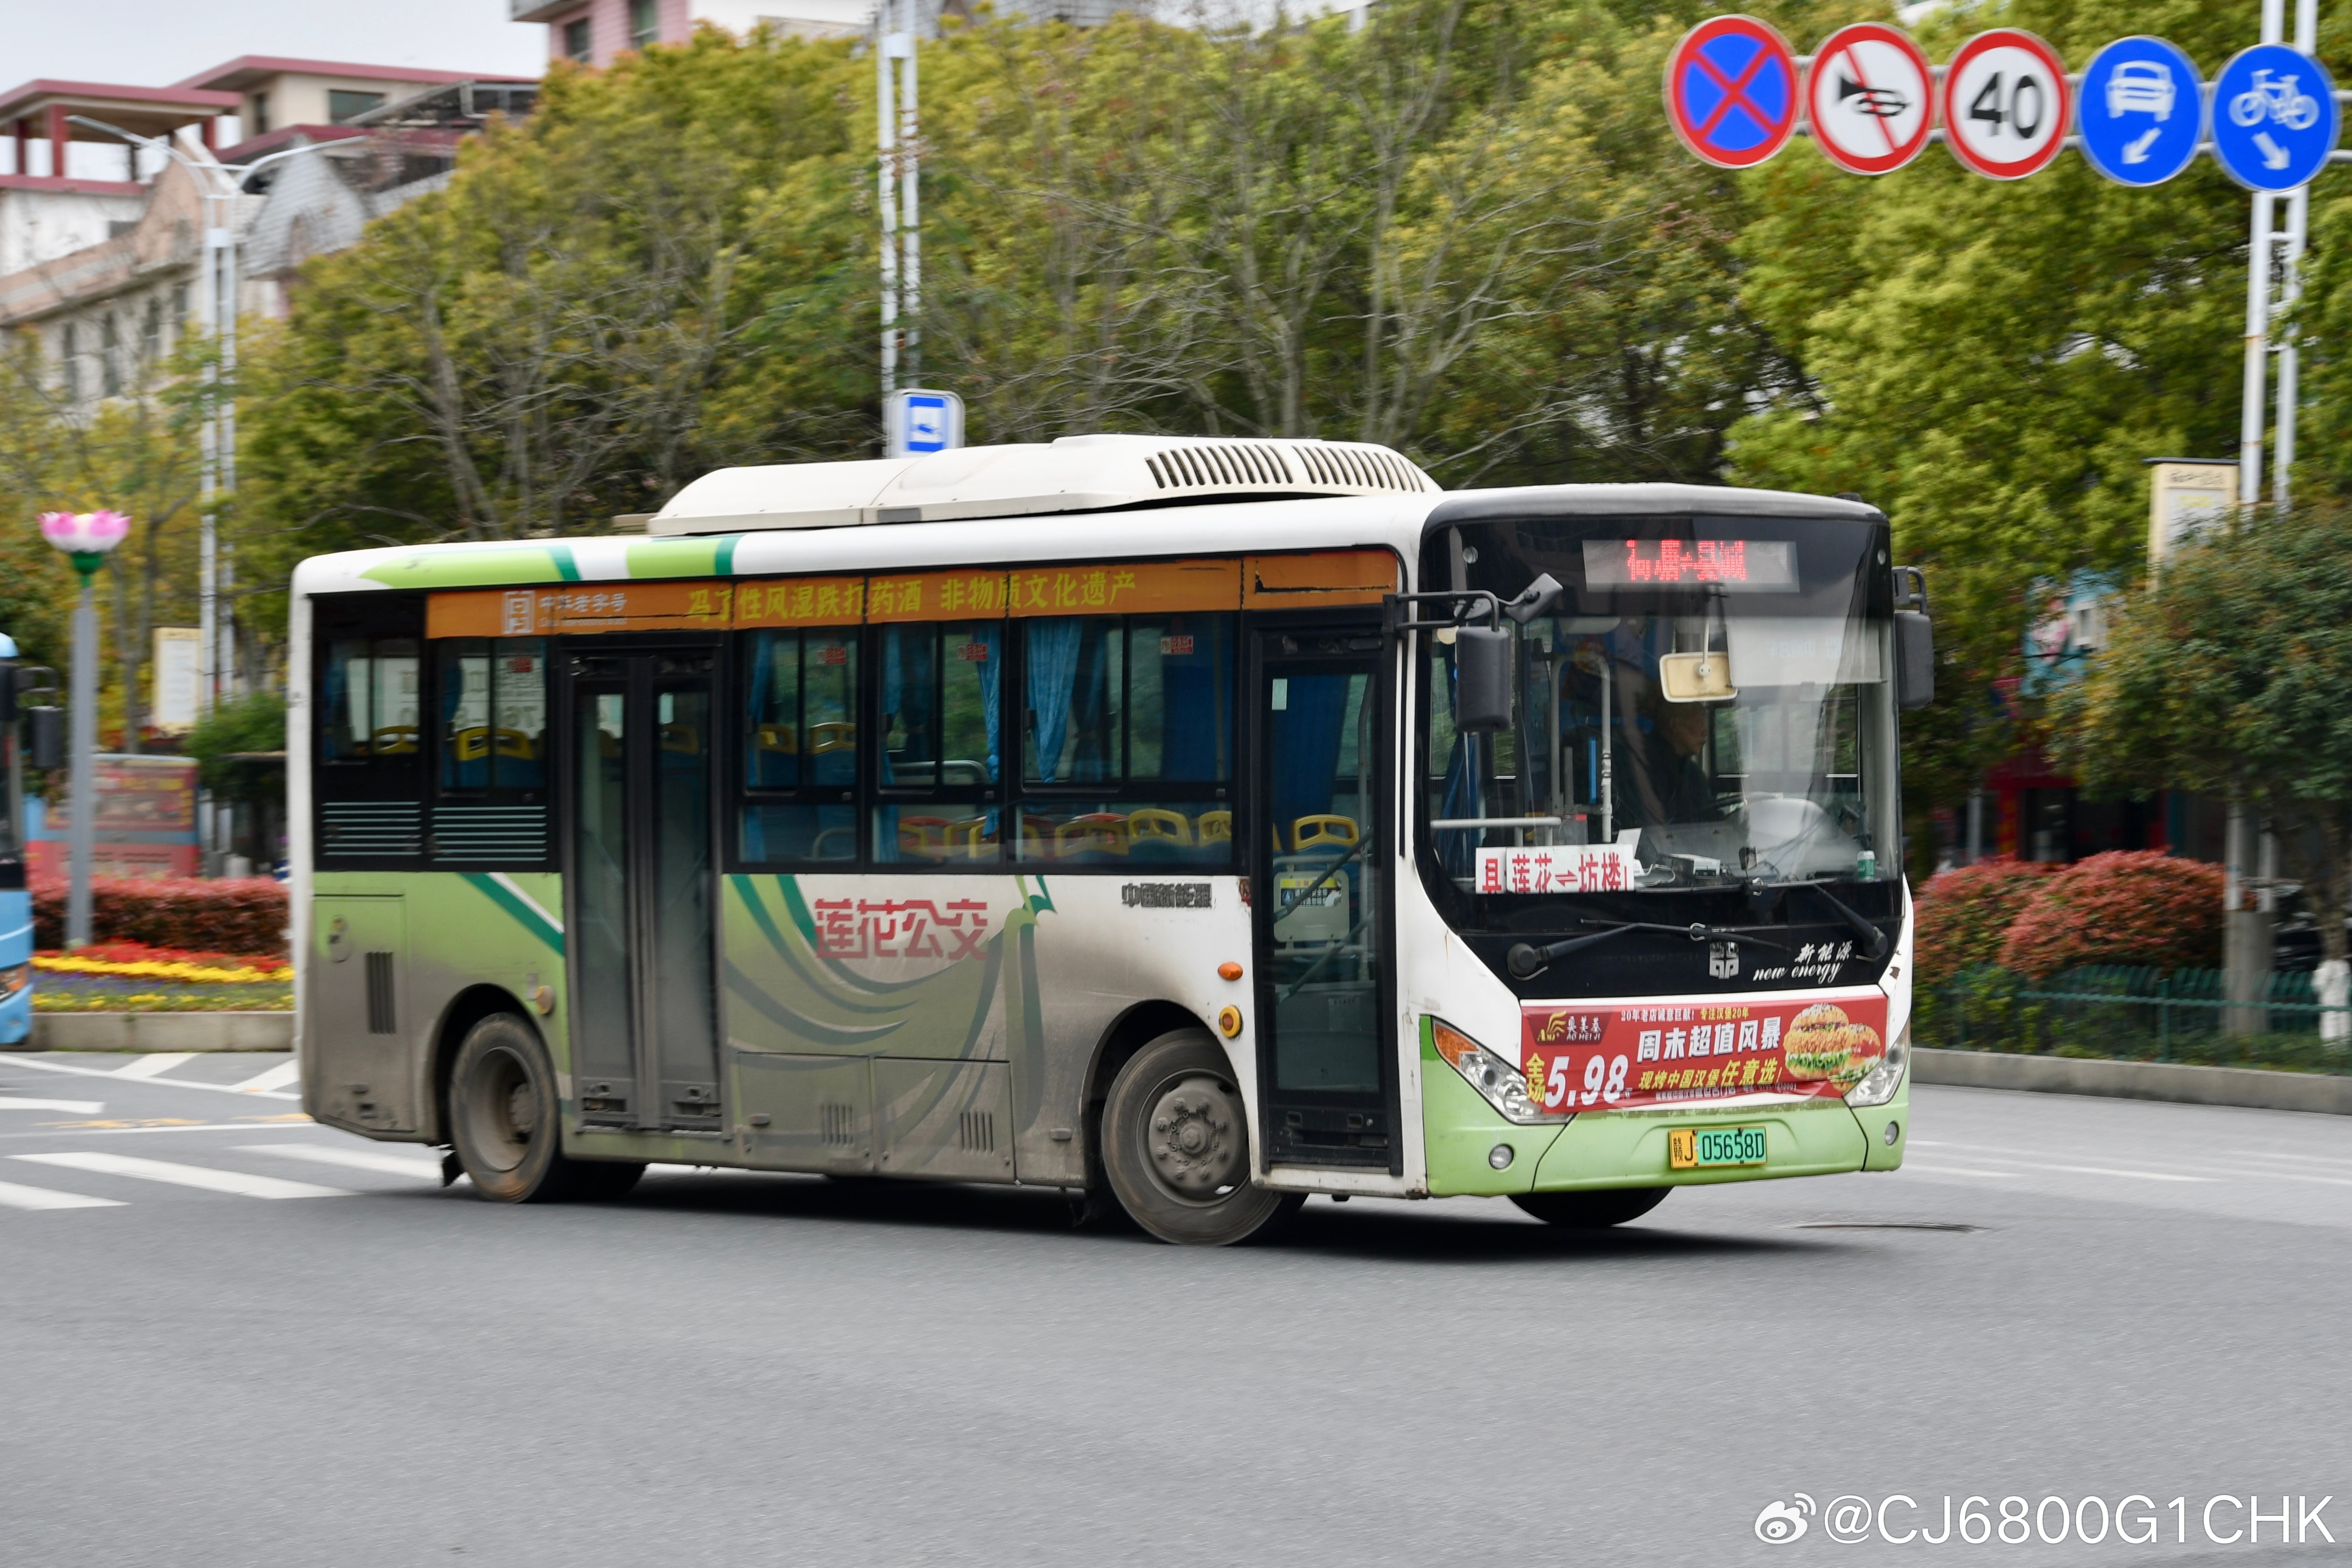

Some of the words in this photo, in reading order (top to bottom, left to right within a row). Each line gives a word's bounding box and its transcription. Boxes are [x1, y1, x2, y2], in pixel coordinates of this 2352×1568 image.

[1968, 71, 2044, 139] 40
[940, 570, 1136, 612] 非物质文化遗产
[815, 898, 988, 960] 莲花公交
[1794, 940, 1853, 963] 新能源
[1753, 966, 1786, 982] new
[1791, 961, 1843, 984] energy
[1637, 1016, 1781, 1064] 周末超值风暴
[1526, 1052, 1545, 1103] 全场
[1545, 1054, 1628, 1108] 5.98
[1702, 1132, 1765, 1160] 05658D
